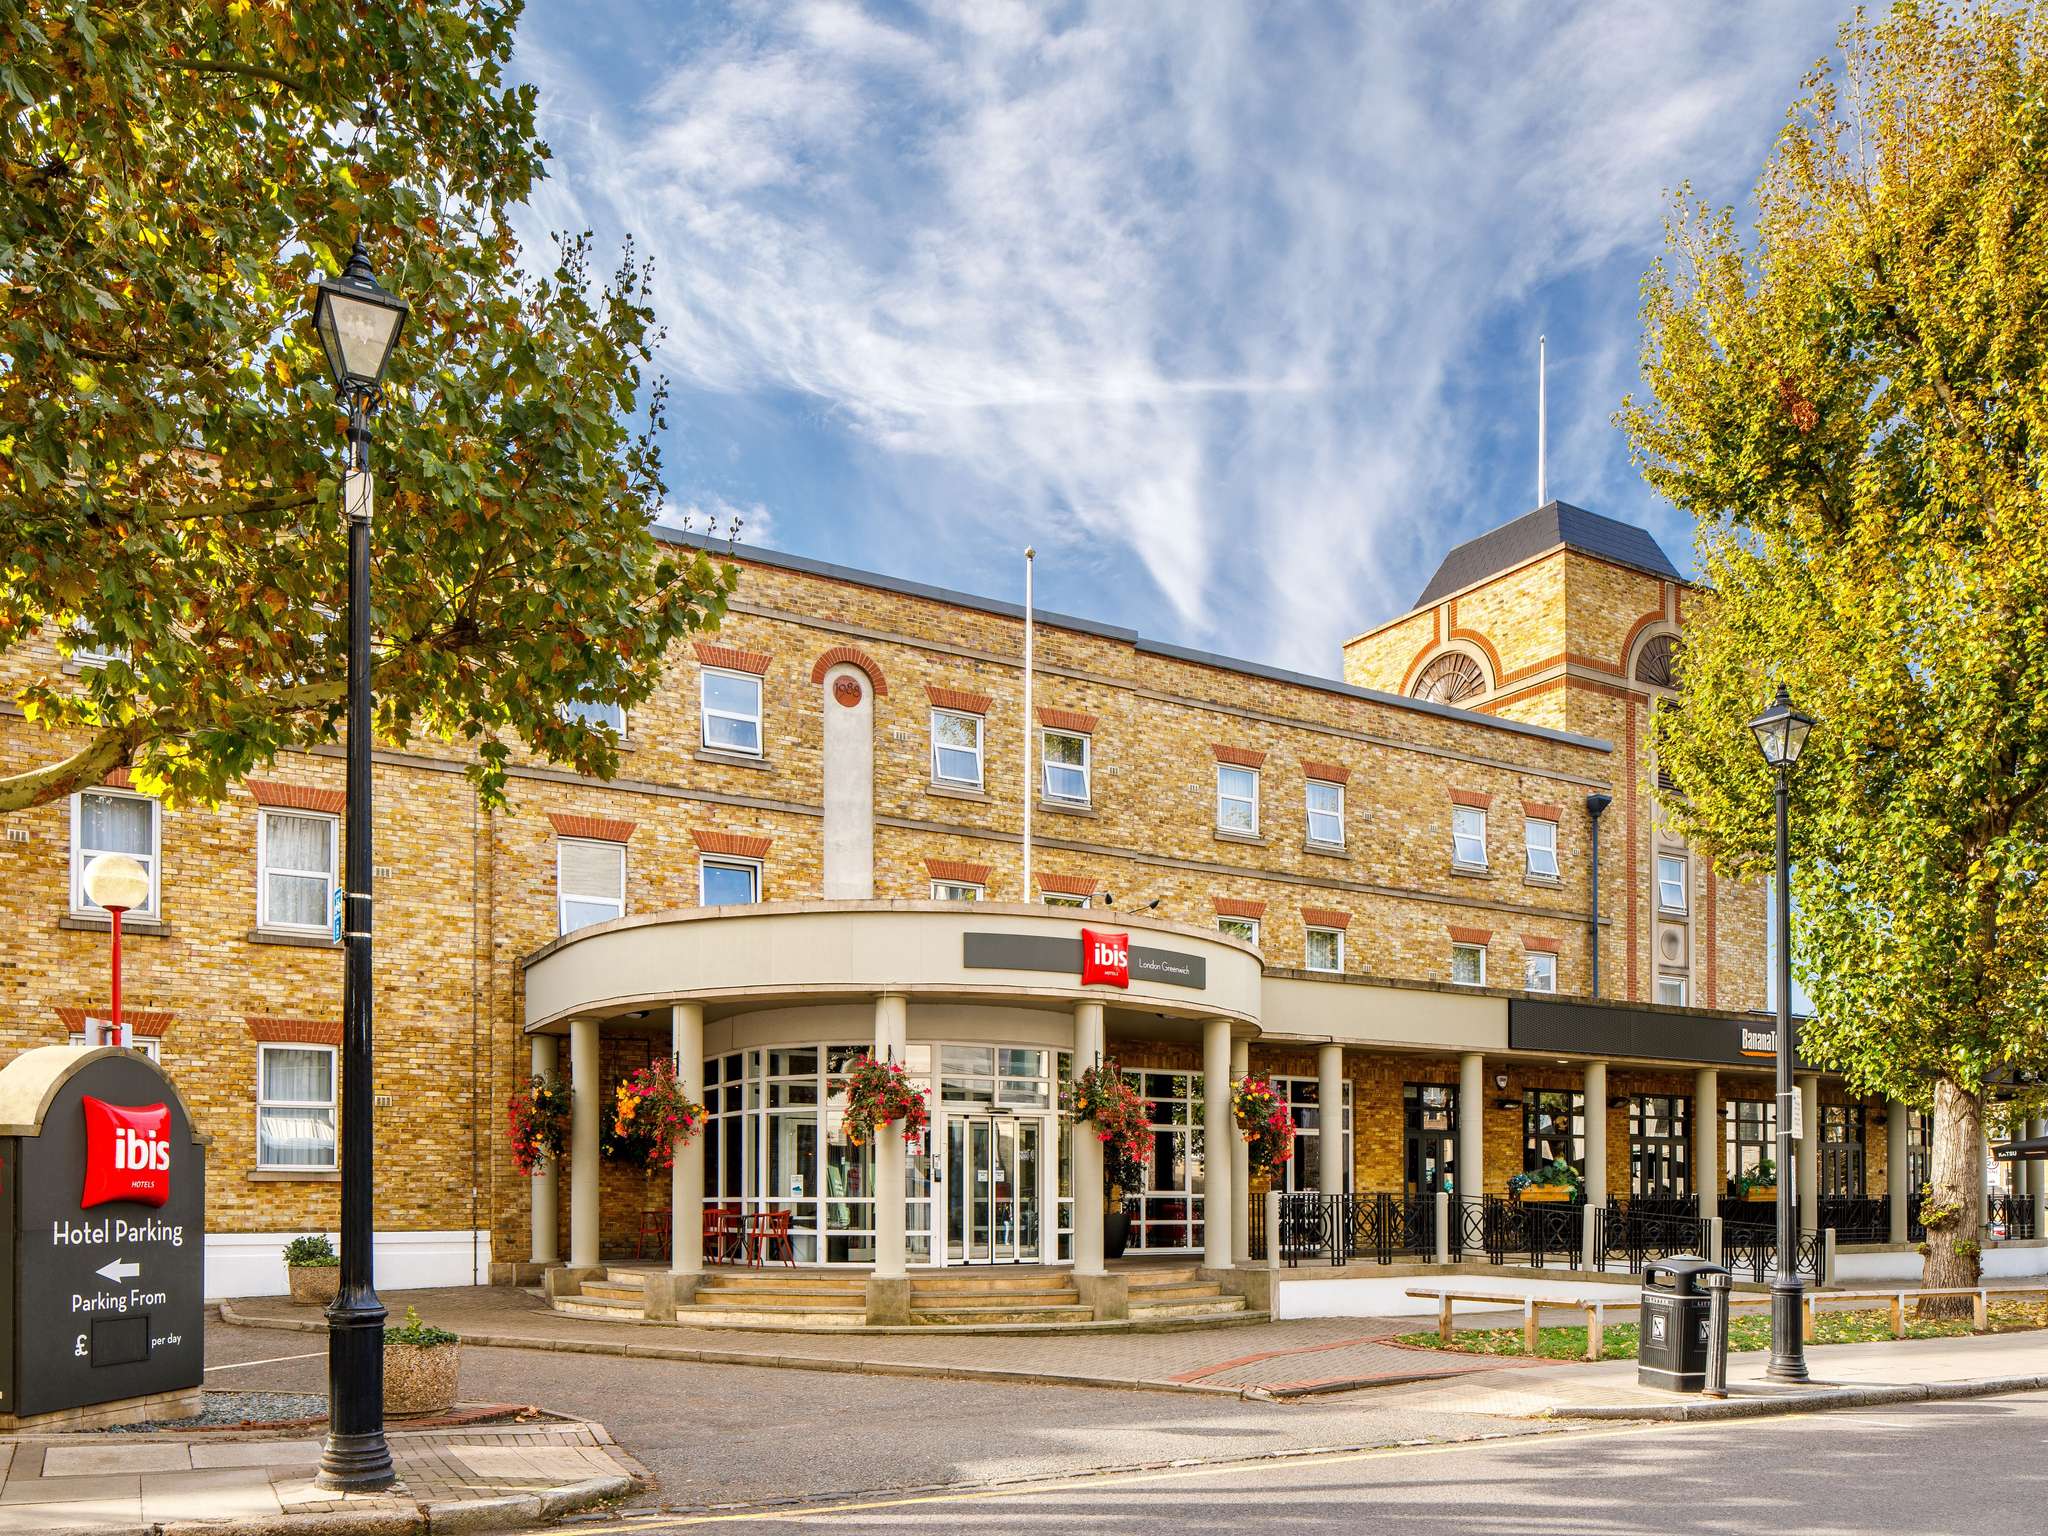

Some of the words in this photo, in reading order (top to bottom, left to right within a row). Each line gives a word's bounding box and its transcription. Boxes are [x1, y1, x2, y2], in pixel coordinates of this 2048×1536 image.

[1094, 943, 1128, 968] ibis
[1138, 958, 1161, 971] London
[1161, 962, 1190, 976] Greenwich
[115, 1128, 170, 1171] ibis
[131, 1180, 155, 1189] HOTELS
[53, 1218, 109, 1246] Hotel
[115, 1217, 183, 1247] Parking
[72, 1291, 127, 1313] Parking
[131, 1289, 166, 1307] From
[74, 1334, 89, 1357] £
[151, 1337, 165, 1349] per
[167, 1332, 182, 1346] day
